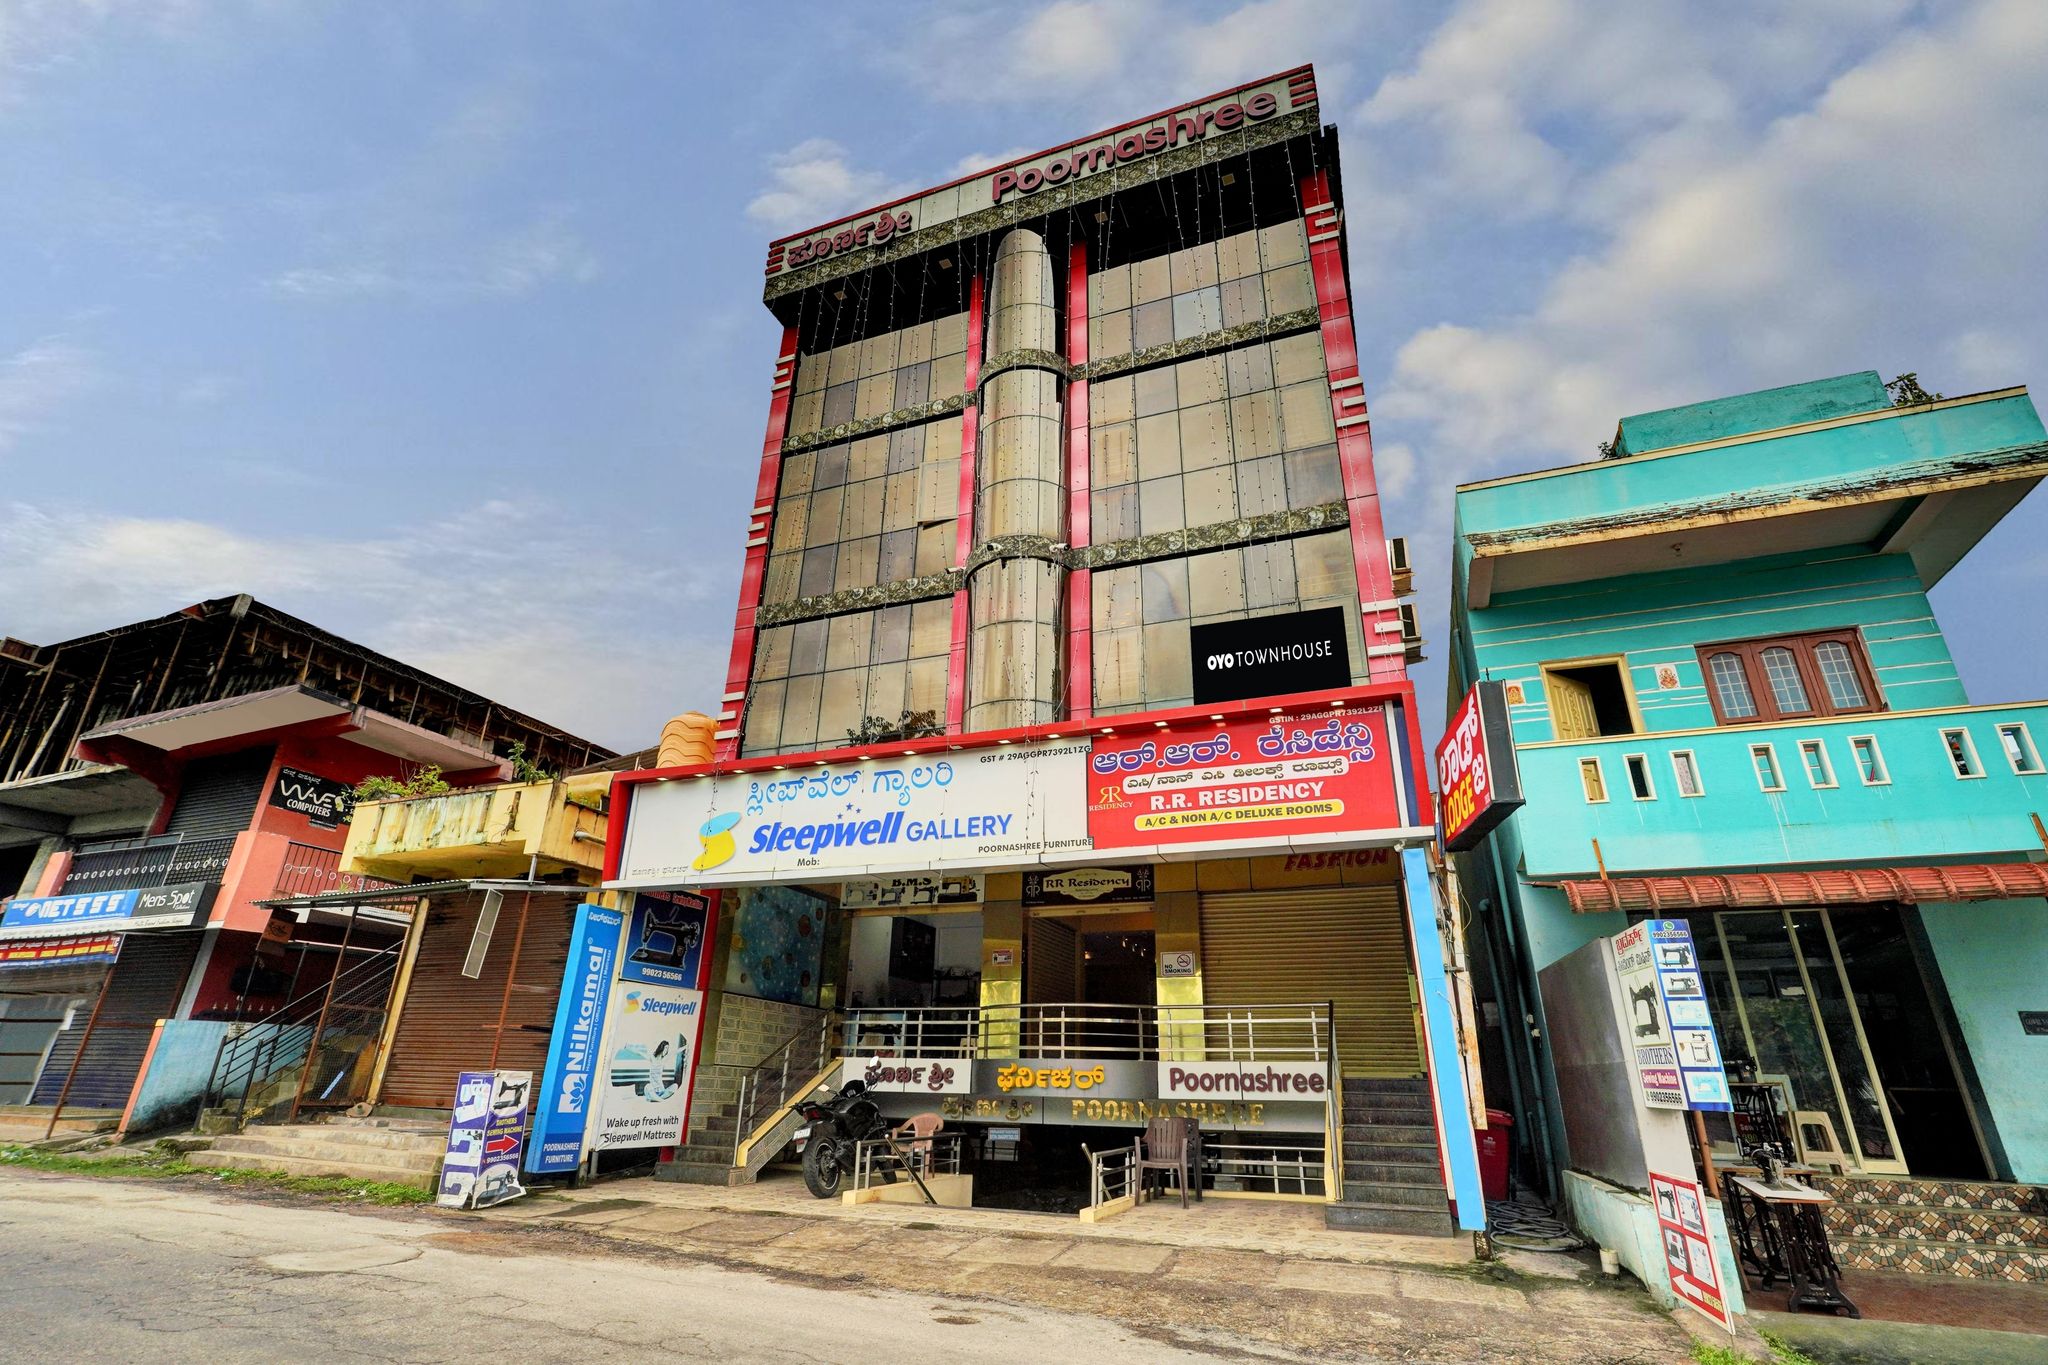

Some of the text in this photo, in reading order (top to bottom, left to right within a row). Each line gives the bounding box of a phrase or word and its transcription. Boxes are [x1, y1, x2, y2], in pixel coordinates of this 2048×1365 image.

[992, 92, 1277, 203] Poornashree
[1207, 640, 1332, 670] OYO TOWNHOUSE
[1269, 715, 1294, 724] GSTIN
[873, 762, 954, 807] ಗ್ಯಾಲರಿ
[1201, 770, 1225, 781] ಎಸಿ
[1150, 781, 1324, 811] R.R. RESIDENCY
[1443, 772, 1476, 838] LODGE
[286, 798, 332, 817] COMPUTERS
[1089, 801, 1133, 812] RESIDENCY
[1145, 804, 1333, 827] A/C & NON A/C DELUXE ROOMS
[906, 814, 1013, 842] GALLERY
[978, 838, 1092, 854] POORNASHREE FURNITURE
[797, 857, 820, 867] Mob:
[1284, 848, 1389, 872] FASHION
[1045, 877, 1129, 888] RR Residency
[139, 890, 195, 909] Mens Spot
[642, 967, 662, 977] 99023
[565, 945, 604, 1073] Nilkamal
[641, 998, 697, 1016] Sleepwell
[1636, 1047, 1674, 1065] BROTHERS
[997, 1062, 1105, 1092] ಫರ್ನಿಚರ್
[1169, 1066, 1325, 1093] Poornashree
[606, 1115, 679, 1128] Wake up fresh with
[1071, 1100, 1265, 1125] POORNASHREE
[604, 1130, 676, 1144] Sleepwell Mattress
[543, 1142, 580, 1152] POORNASHREE
[545, 1154, 574, 1164] FURNITURE
